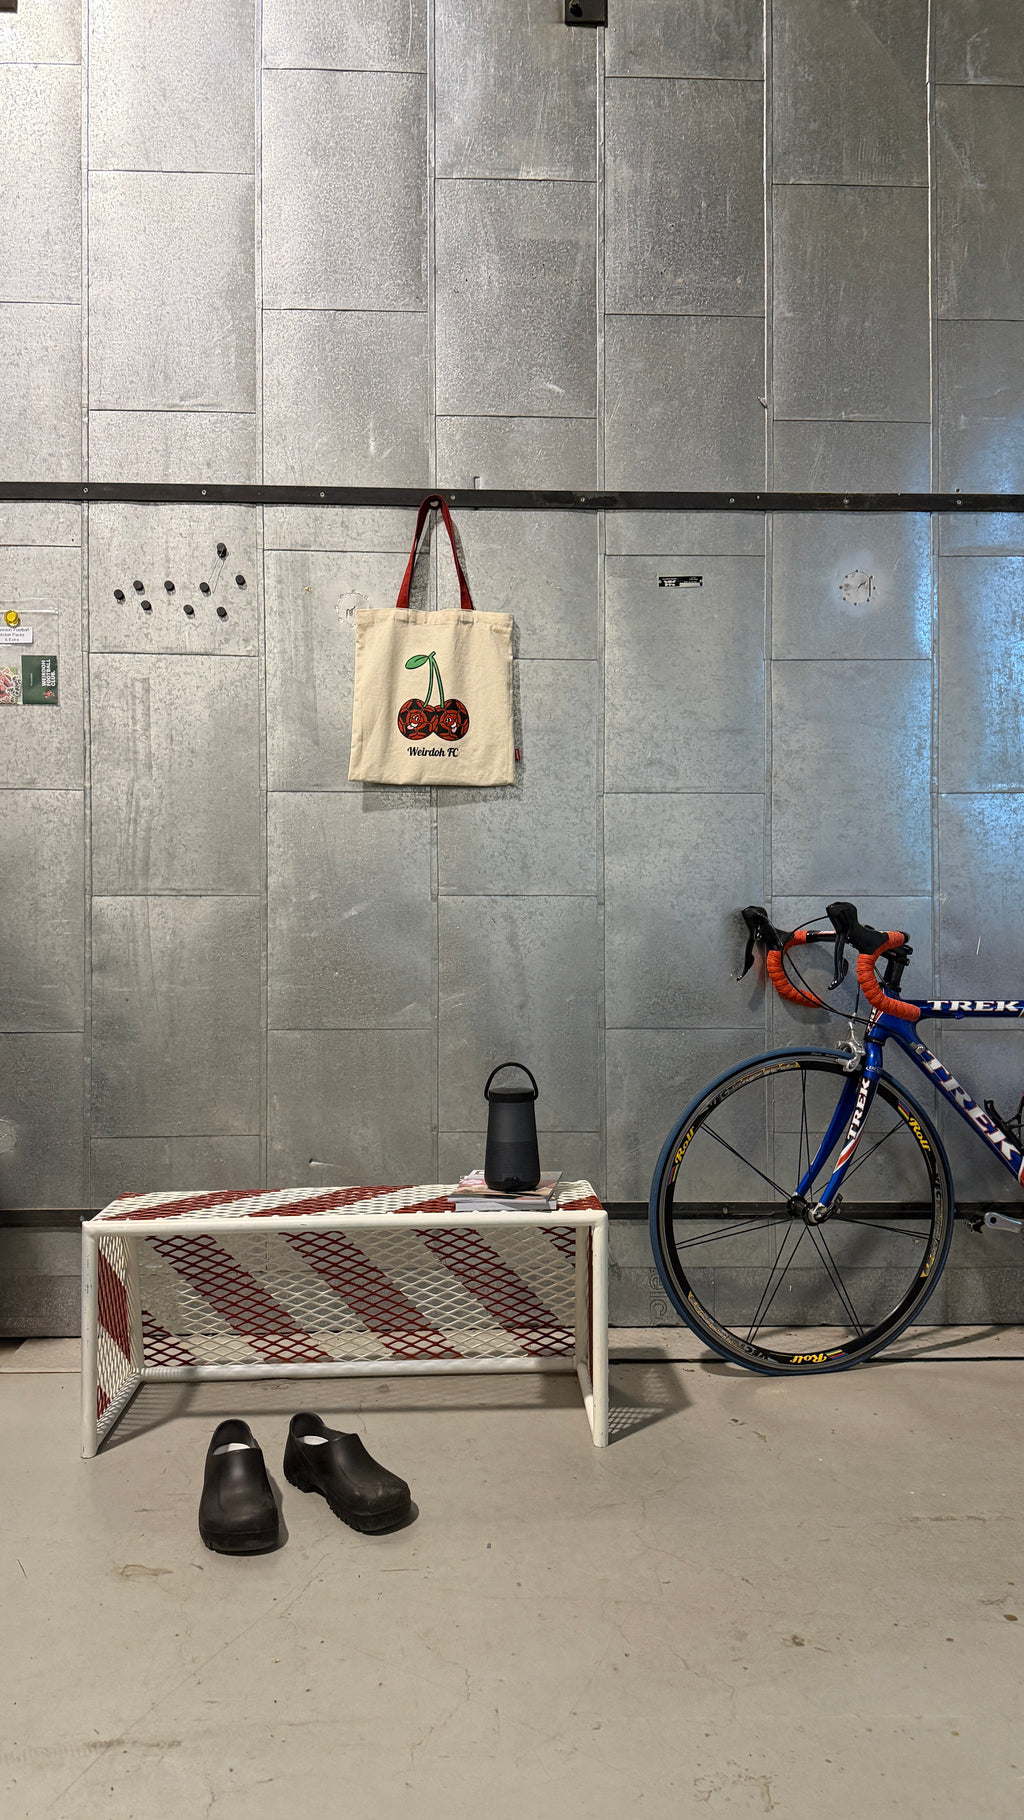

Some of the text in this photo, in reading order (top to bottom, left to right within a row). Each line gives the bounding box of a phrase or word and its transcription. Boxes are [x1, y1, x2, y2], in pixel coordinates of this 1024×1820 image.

[407, 747, 459, 758] Weirdoh FC
[927, 1000, 1020, 1012] TREK
[846, 1077, 871, 1140] TREK
[920, 1050, 1022, 1161] TREK
[674, 1126, 695, 1164] Rolf
[909, 1117, 932, 1153] Rolf
[789, 1353, 828, 1364] Rolf
